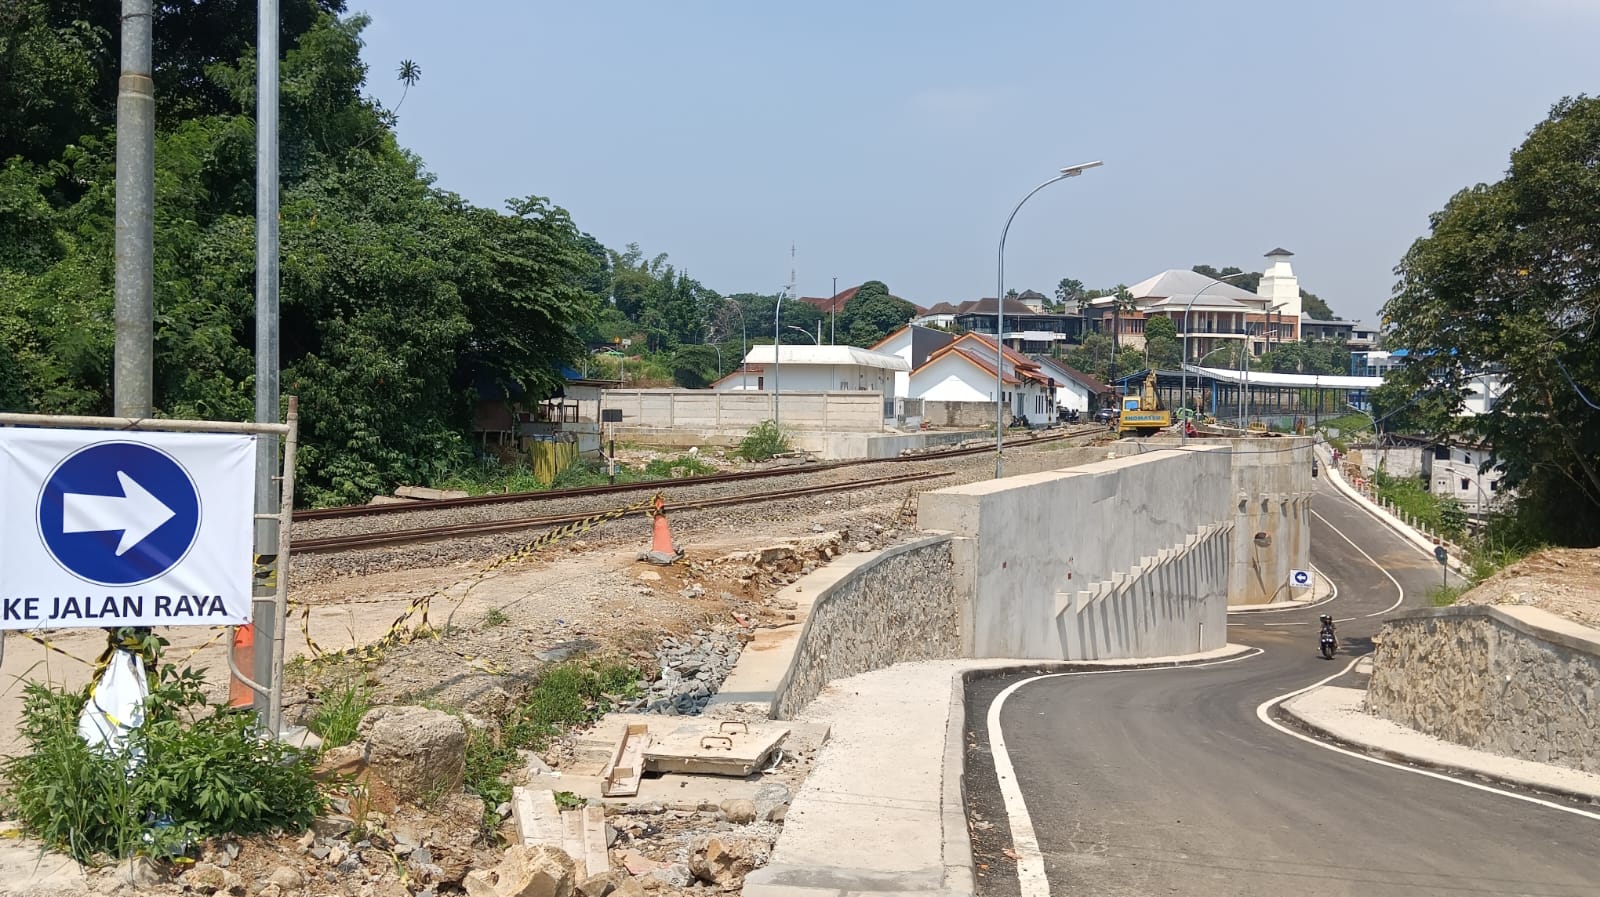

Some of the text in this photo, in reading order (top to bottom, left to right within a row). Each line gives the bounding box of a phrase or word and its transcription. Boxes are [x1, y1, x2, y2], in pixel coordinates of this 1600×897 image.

[3, 595, 228, 620] KE JALAN RAYA
